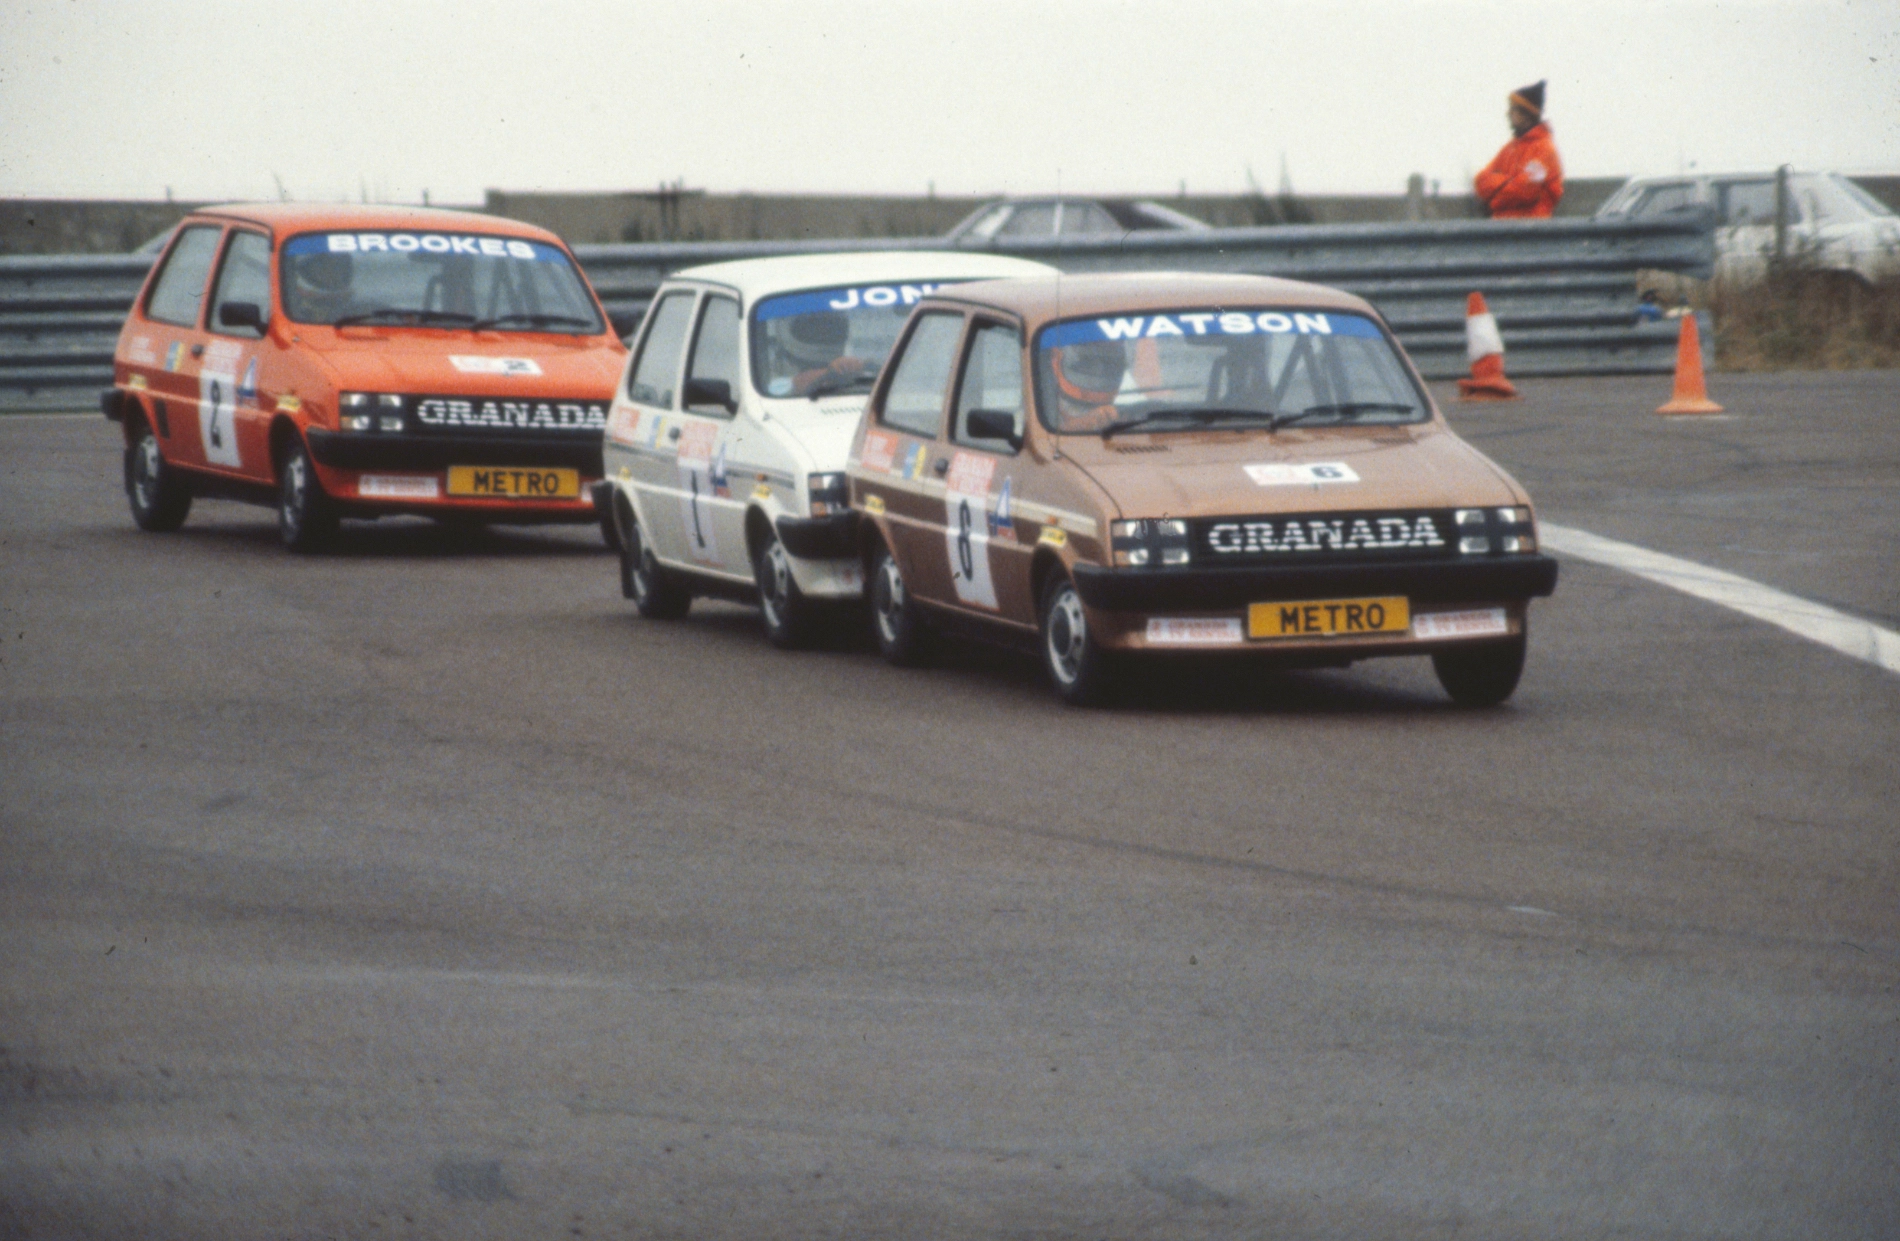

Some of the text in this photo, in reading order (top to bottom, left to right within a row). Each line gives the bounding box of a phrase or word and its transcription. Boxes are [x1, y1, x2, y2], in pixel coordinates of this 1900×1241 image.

[327, 233, 536, 260] BROOKES
[1098, 312, 1333, 340] WATSON
[417, 399, 606, 429] GRANADA
[473, 470, 560, 494] METRO
[1311, 465, 1343, 479] 6
[691, 470, 706, 548] 1
[1208, 517, 1446, 553] GRANADA
[1279, 603, 1385, 633] METRO
